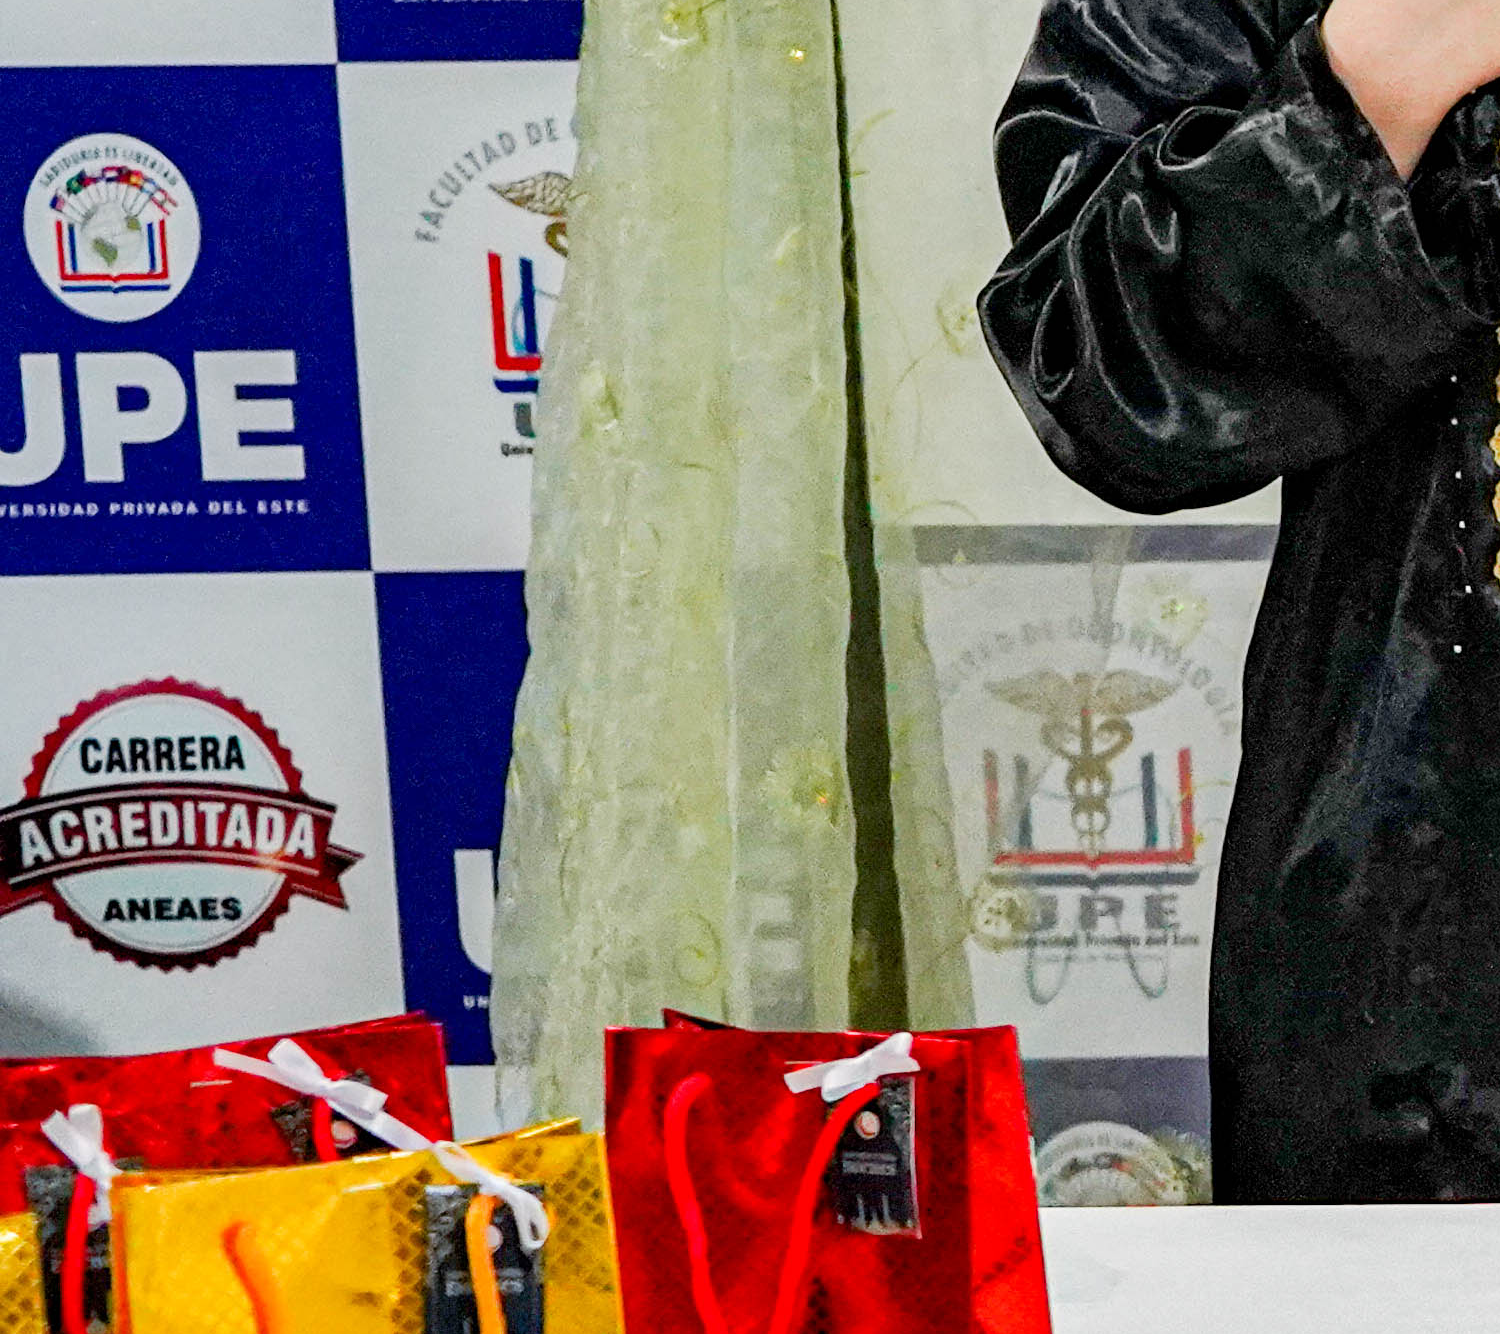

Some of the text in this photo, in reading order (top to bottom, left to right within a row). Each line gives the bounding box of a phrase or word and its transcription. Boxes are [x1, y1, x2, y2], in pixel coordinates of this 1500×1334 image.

[414, 117, 559, 243] FACULTAD DE
[109, 500, 199, 515] PRIVADA
[208, 500, 247, 515] DEL
[257, 499, 310, 515] ESTE
[80, 735, 246, 773] CARRERA
[19, 800, 316, 868] ACREDITADA
[103, 897, 242, 922] ANEAES
